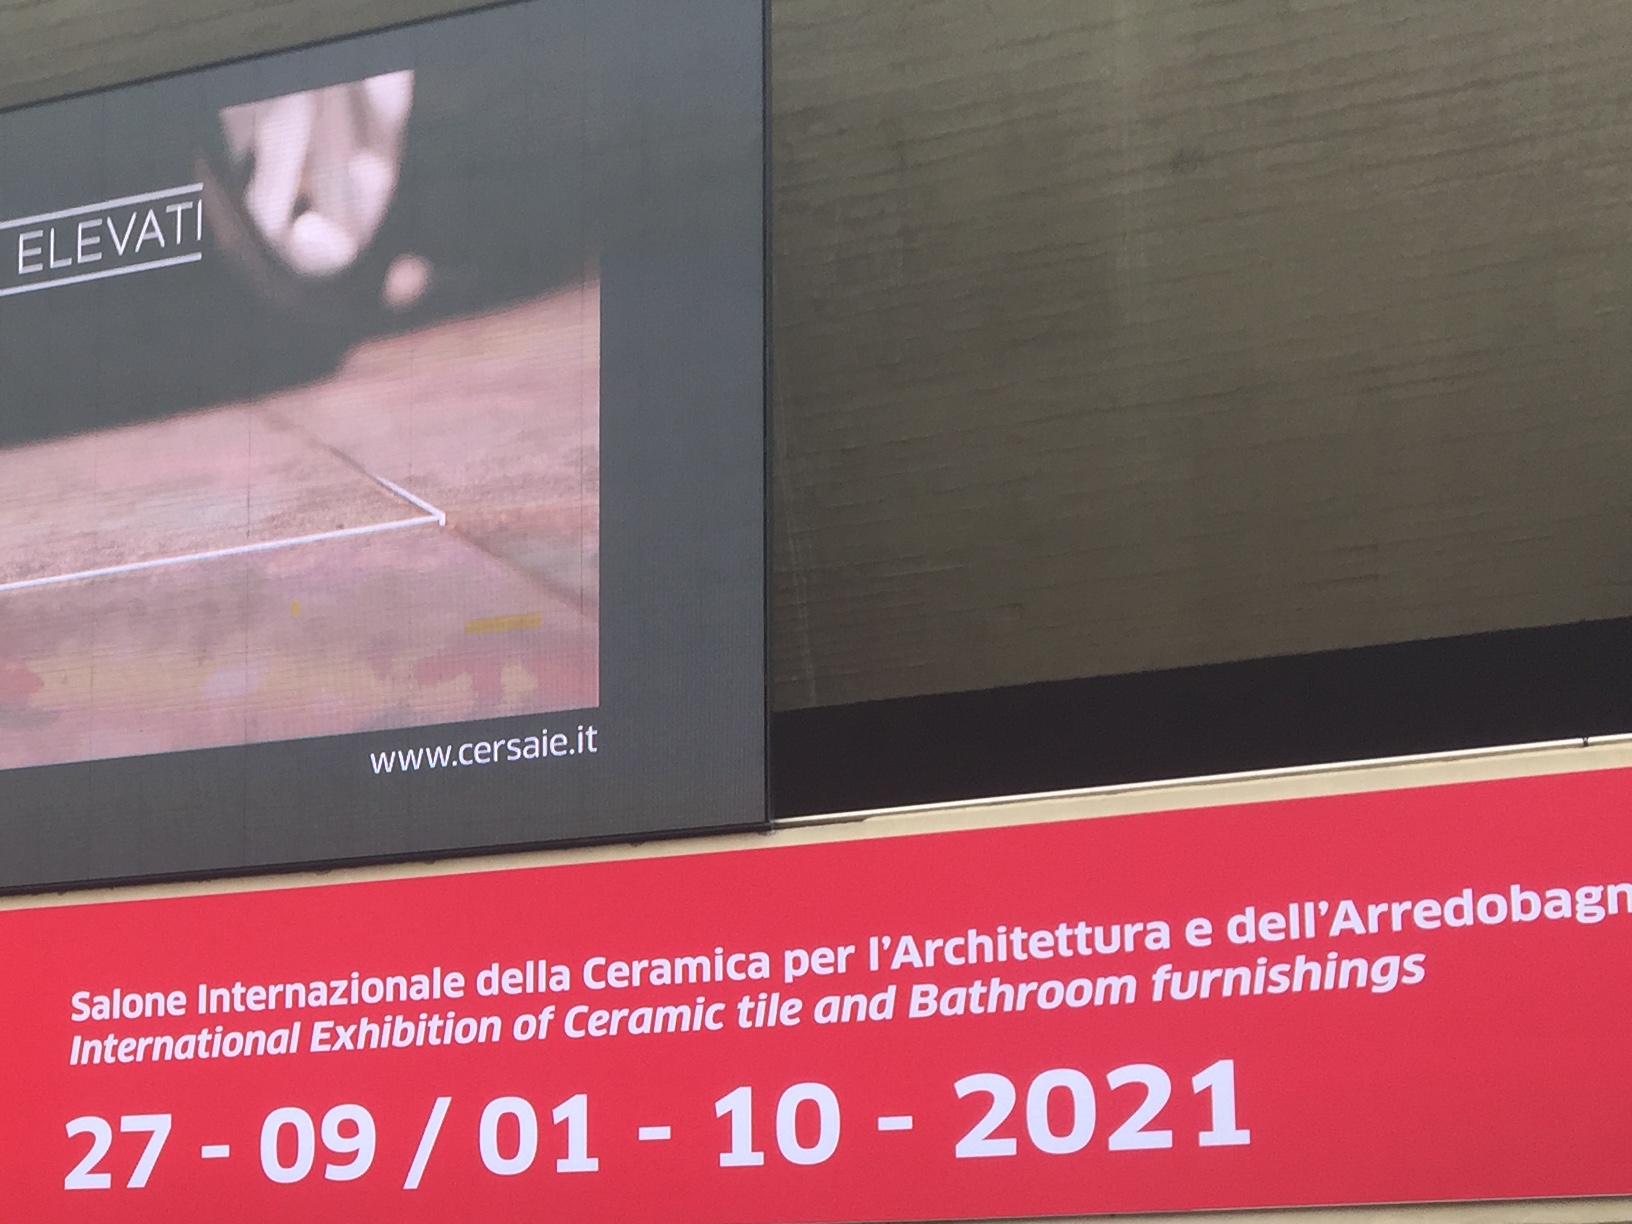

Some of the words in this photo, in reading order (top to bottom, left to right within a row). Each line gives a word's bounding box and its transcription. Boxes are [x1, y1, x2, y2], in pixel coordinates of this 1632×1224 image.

[18, 199, 203, 275] ELEVATI
[371, 724, 598, 774] www.cersaie.it
[70, 1021, 301, 1065] International
[310, 1011, 502, 1052] Exhibition
[514, 997, 558, 1040] of
[565, 994, 726, 1034] Ceramic
[737, 992, 803, 1029] tile
[814, 984, 897, 1024] and
[908, 974, 1137, 1018] Bathroom
[1151, 951, 1426, 1002] furnishings
[71, 988, 187, 1022] Salone
[198, 966, 465, 1014] Internazionale
[476, 959, 571, 996] della
[583, 946, 770, 990] Ceramica
[784, 945, 856, 983] per
[869, 920, 1171, 971] l'Architettura
[1185, 917, 1213, 947] e
[64, 1113, 172, 1190] 27
[201, 1144, 230, 1159] -
[260, 1103, 377, 1184] 09
[403, 1096, 452, 1190] /
[479, 1093, 599, 1176] 01
[638, 1125, 671, 1141] -
[714, 1082, 841, 1167] 10
[877, 1115, 913, 1131] -
[954, 1059, 1251, 1158] 2021
